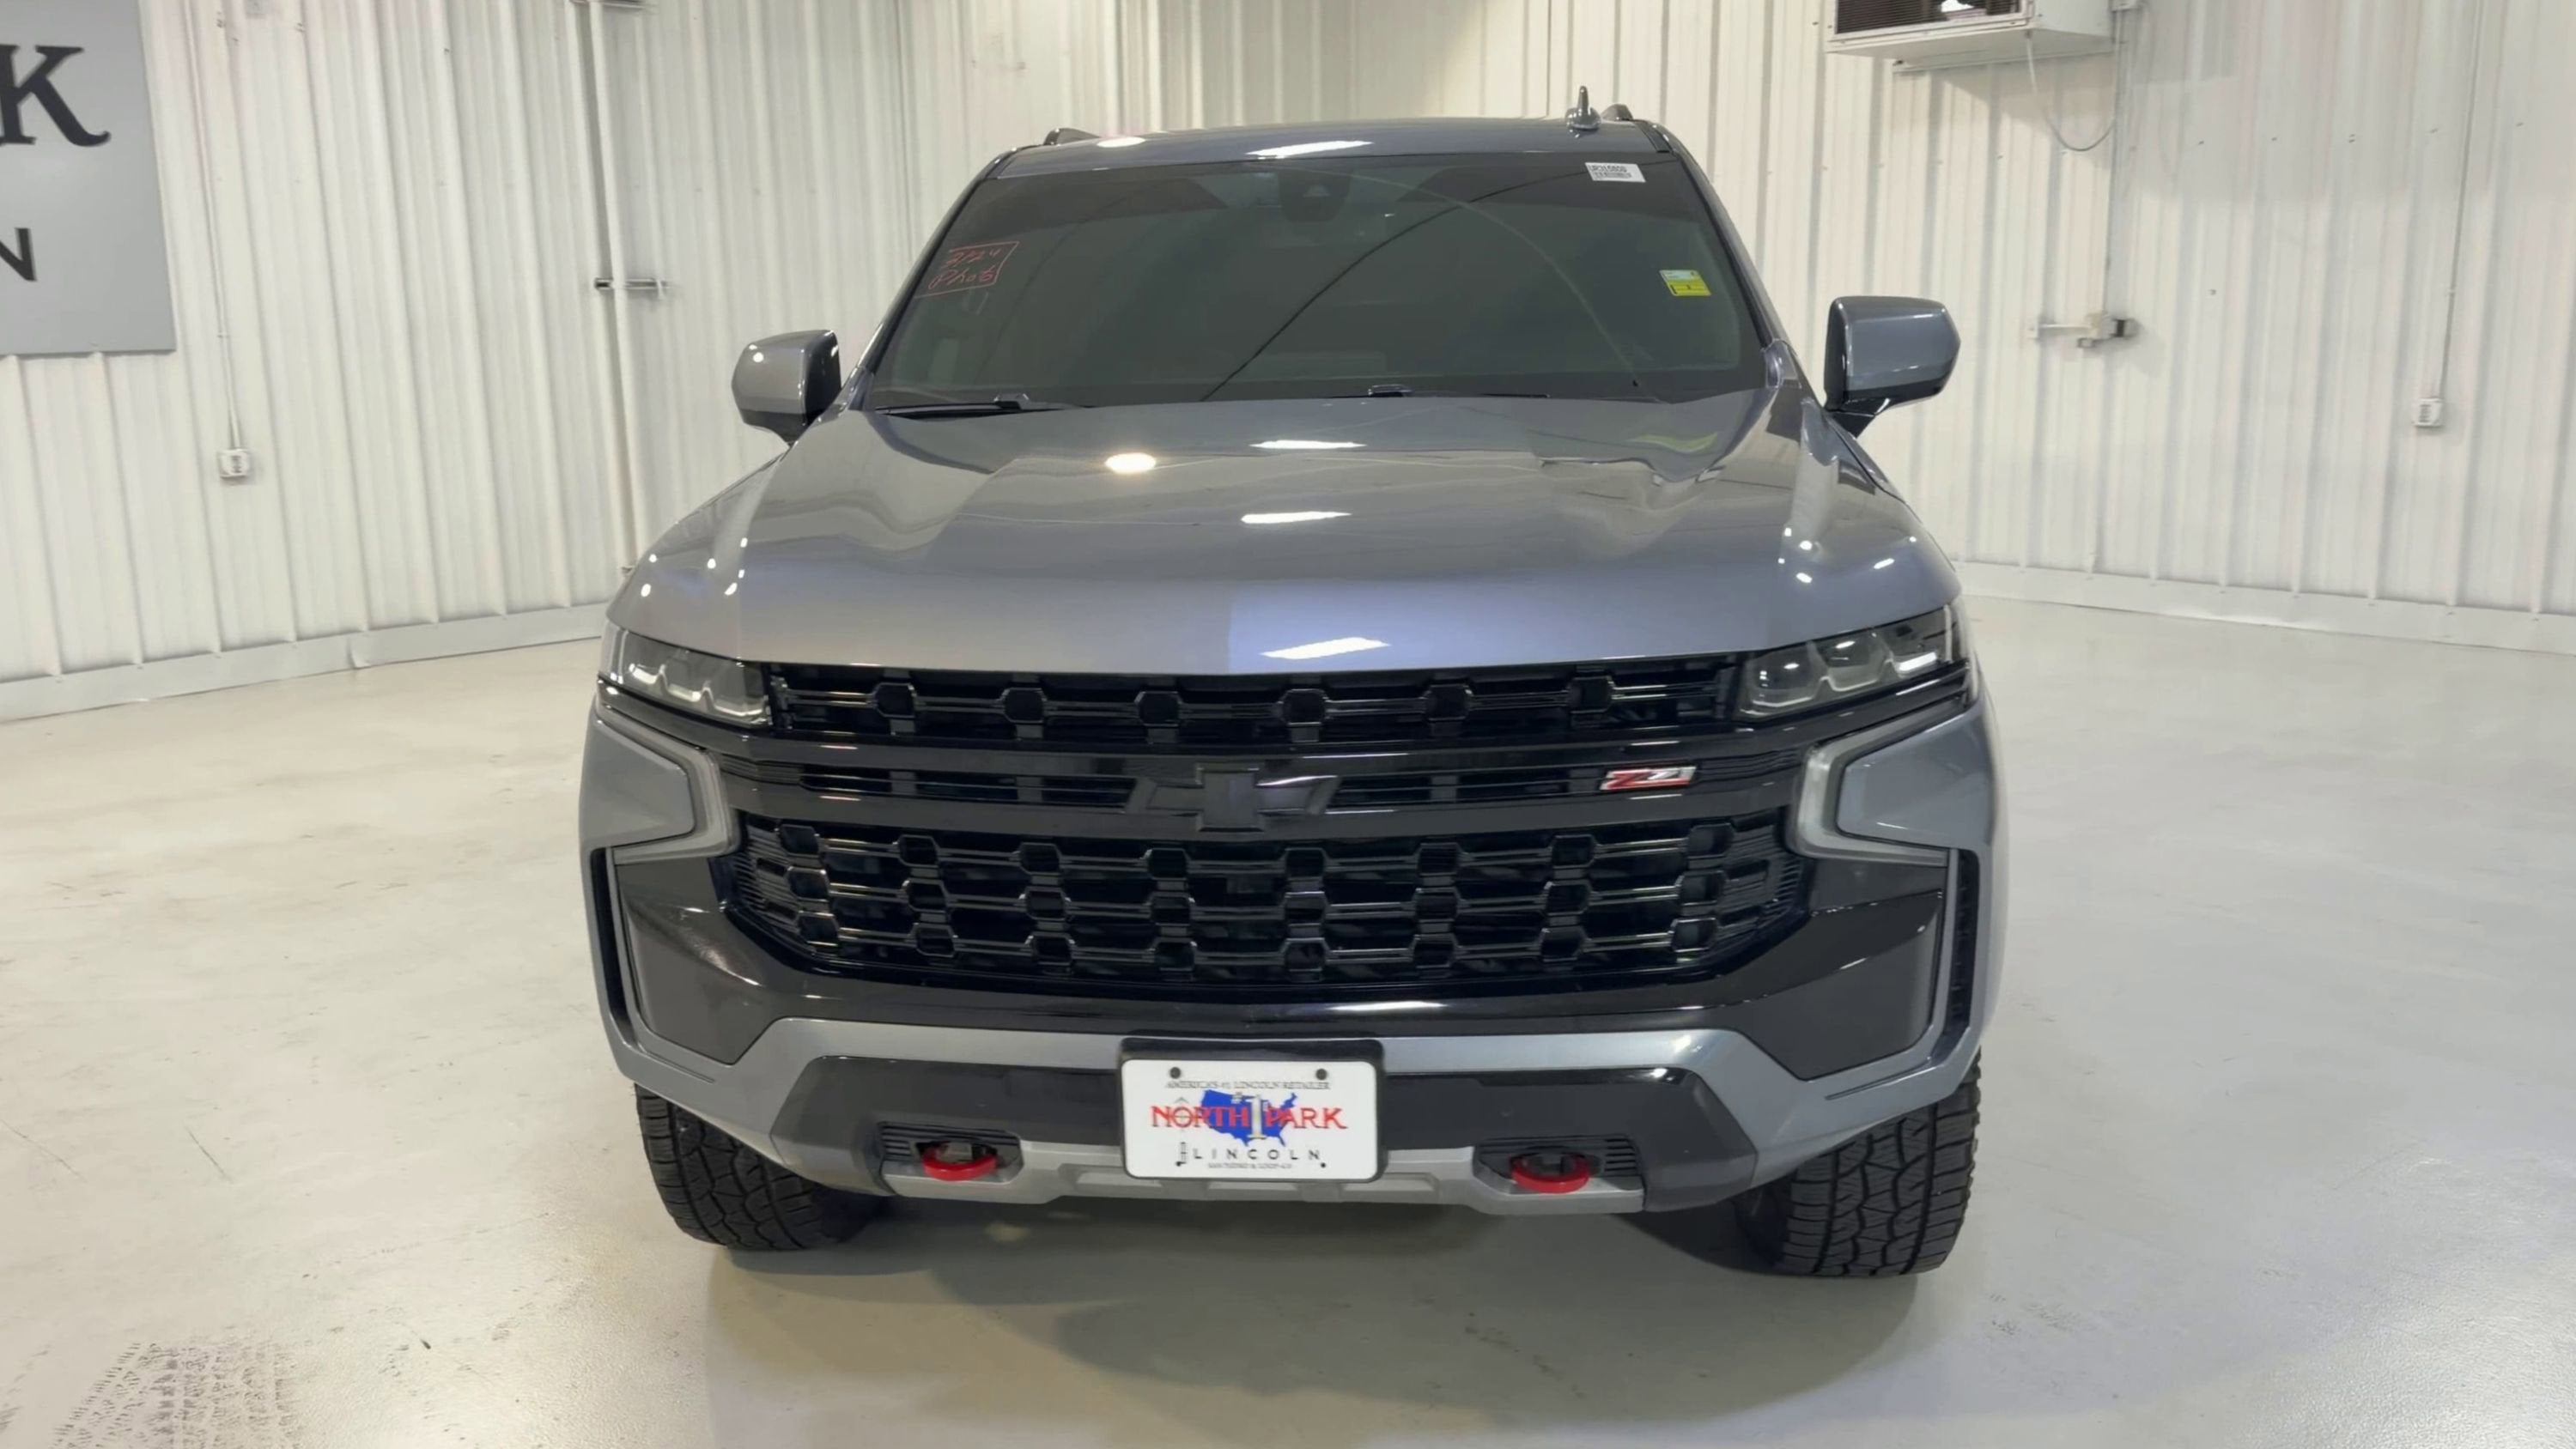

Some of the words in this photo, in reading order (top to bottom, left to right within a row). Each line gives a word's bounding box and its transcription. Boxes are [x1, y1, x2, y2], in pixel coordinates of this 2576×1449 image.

[1151, 1106, 1248, 1129] NORTH
[1266, 1106, 1348, 1129] PARK
[1193, 1148, 1321, 1161] LINCOLN
